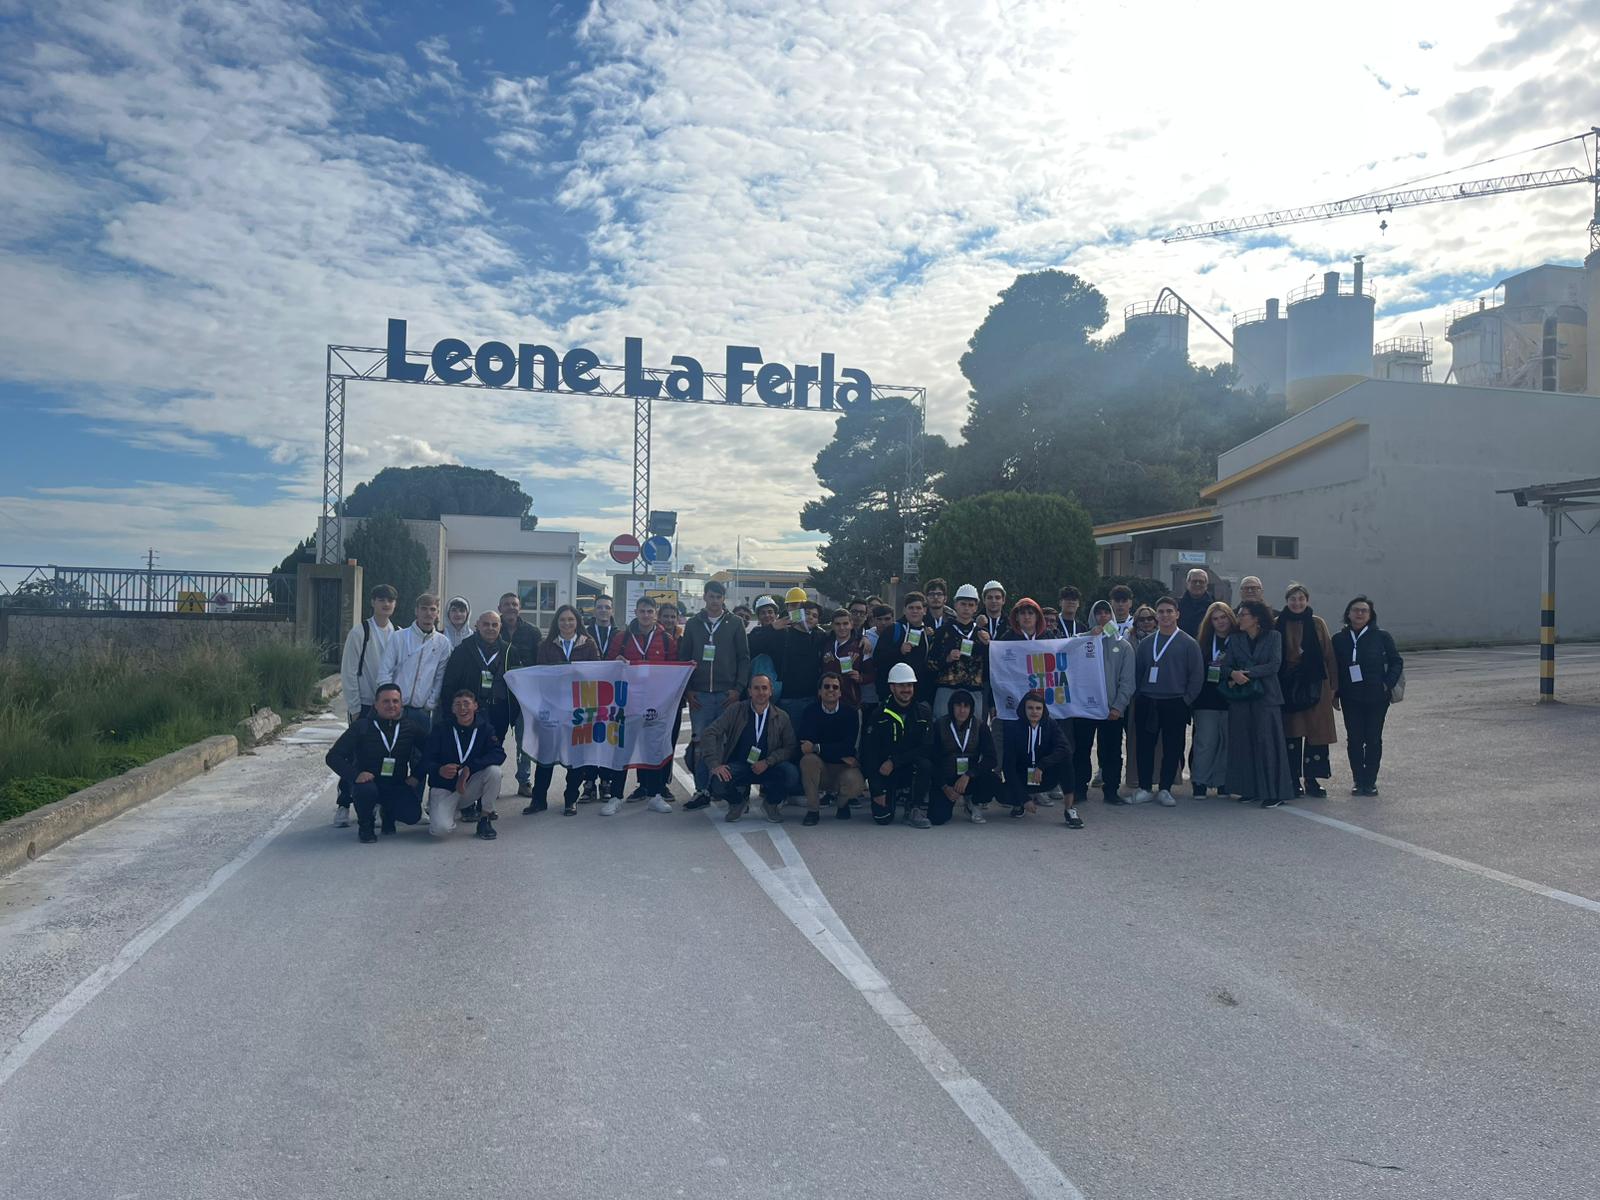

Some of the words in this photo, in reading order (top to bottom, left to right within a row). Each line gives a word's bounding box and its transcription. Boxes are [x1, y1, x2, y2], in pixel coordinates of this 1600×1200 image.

[386, 318, 601, 392] Leone
[625, 337, 704, 400] La
[726, 345, 873, 410] Ferla
[1026, 652, 1068, 674] INDU
[1028, 671, 1069, 689] STRIA
[572, 680, 628, 708] INDU
[571, 706, 626, 726] STRIA
[571, 721, 625, 748] MOCI
